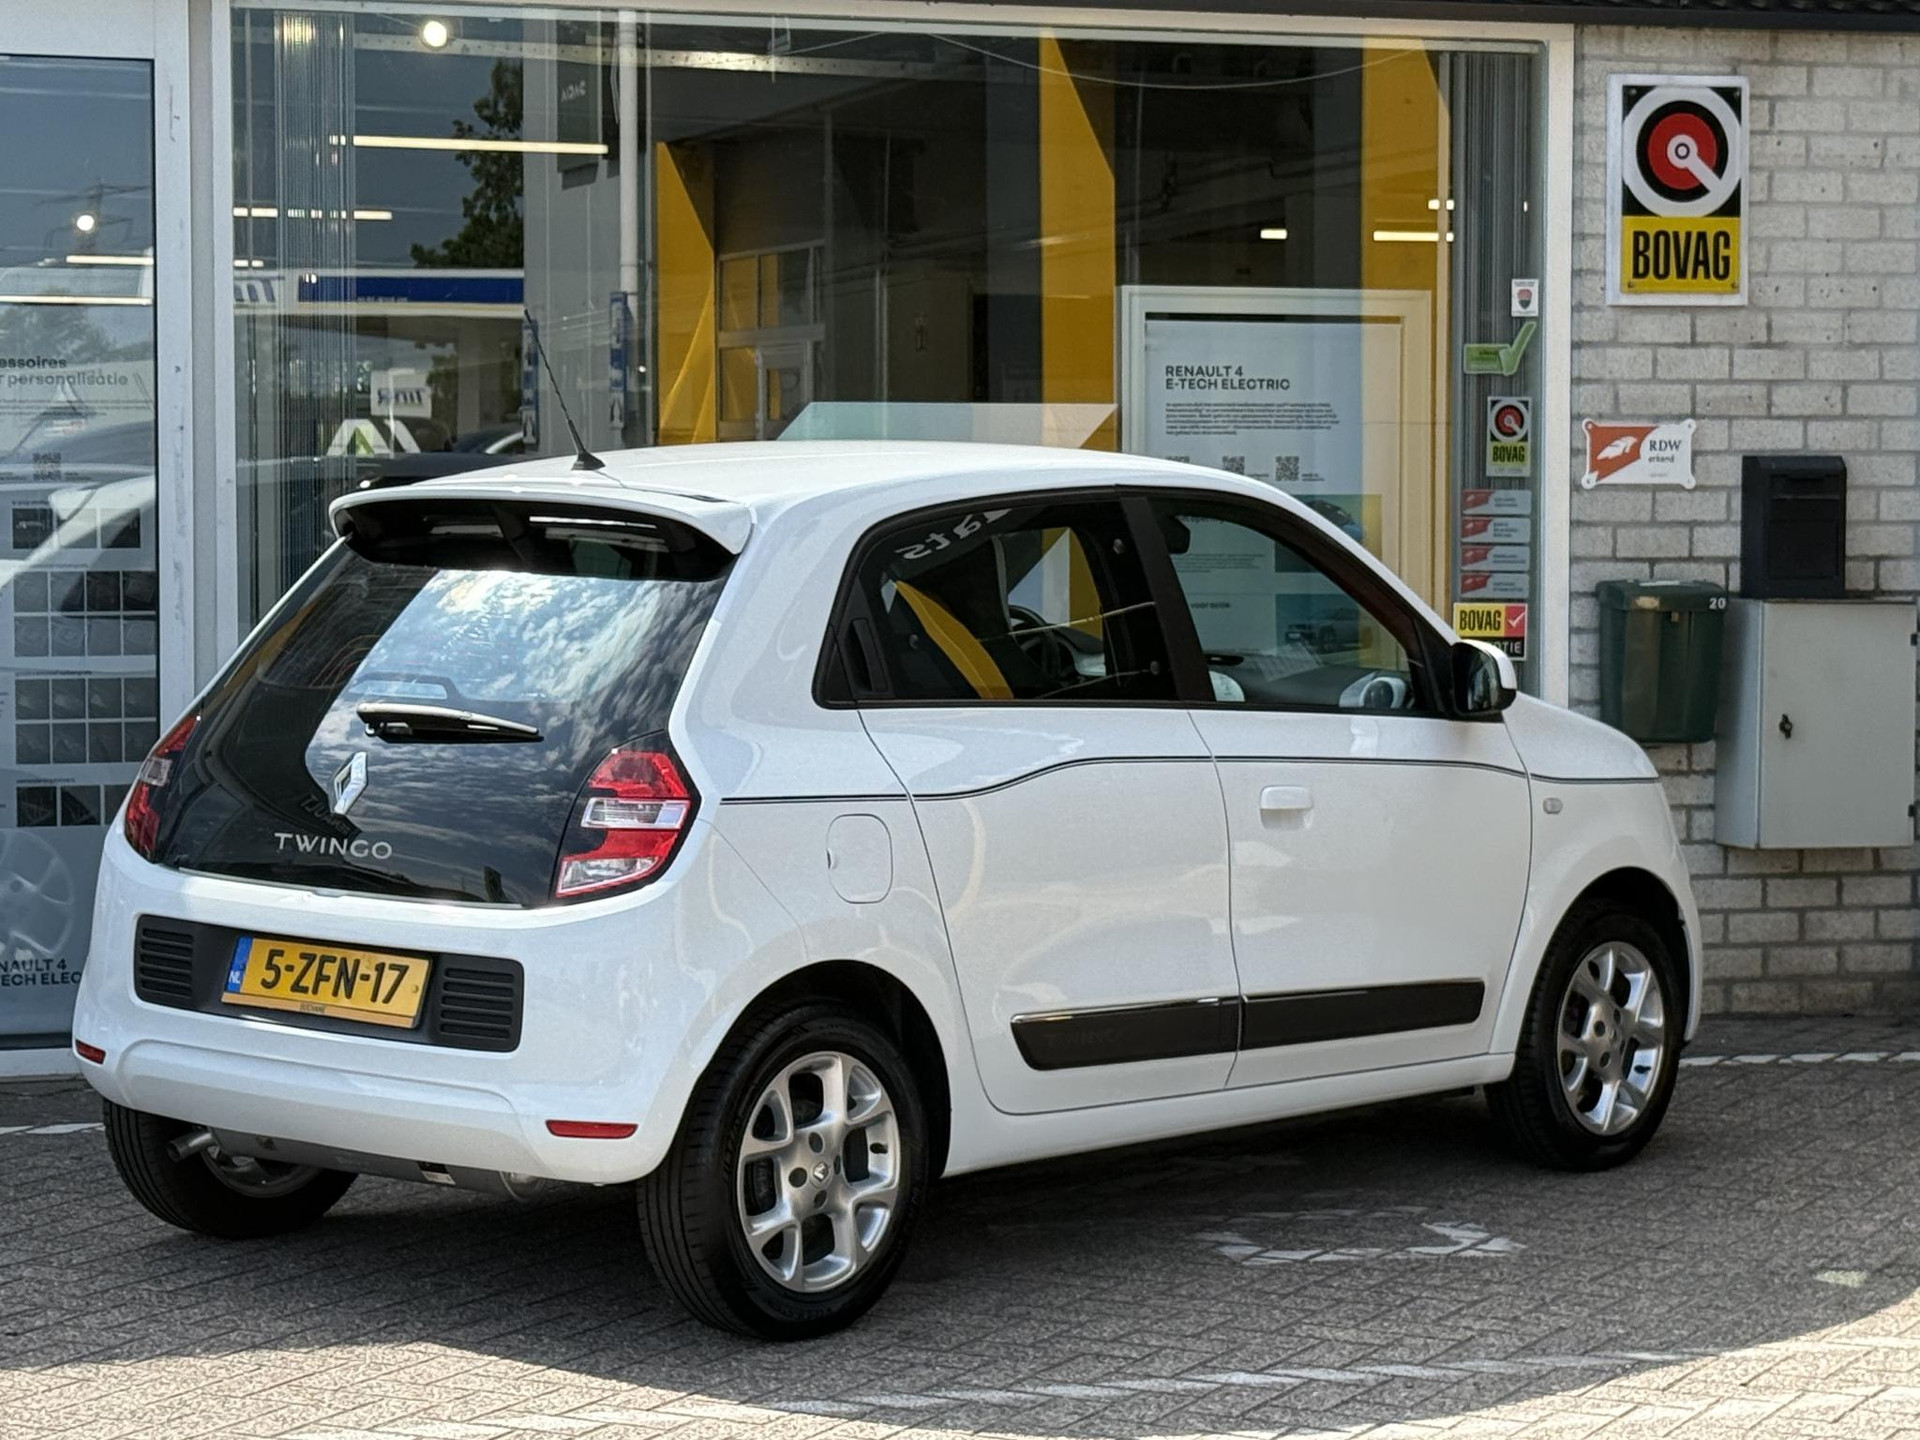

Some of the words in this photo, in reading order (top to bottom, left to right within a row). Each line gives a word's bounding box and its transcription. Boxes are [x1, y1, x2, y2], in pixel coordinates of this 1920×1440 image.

[1632, 230, 1731, 281] BOVAG
[1165, 365, 1232, 377] RENAULT
[1234, 365, 1243, 377] 4
[1165, 378, 1218, 390] E-TECH
[1221, 378, 1290, 390] ELECTRIC
[1649, 439, 1682, 451] RDW
[1492, 444, 1525, 463] BOVAG
[1709, 598, 1726, 610] 20
[1459, 609, 1501, 632] BOVAG
[274, 832, 392, 860] TWINGO
[56, 958, 67, 970] 4
[228, 970, 241, 984] NL
[260, 949, 410, 1004] 5-ZFN-17
